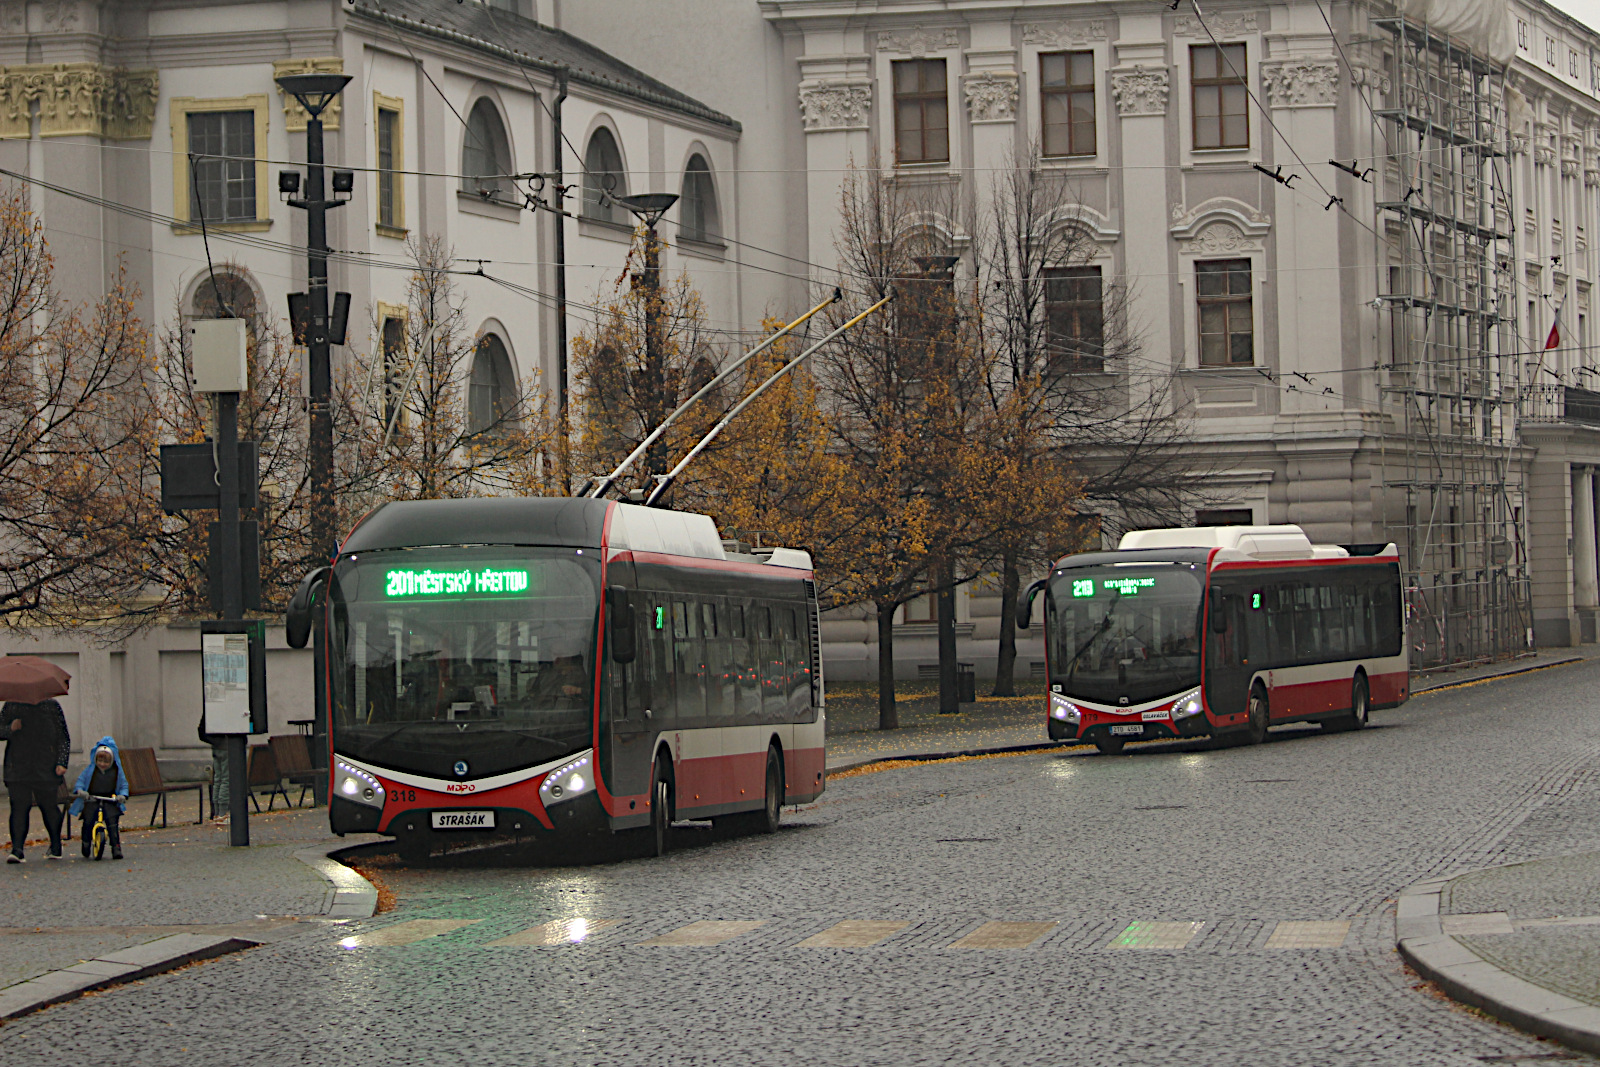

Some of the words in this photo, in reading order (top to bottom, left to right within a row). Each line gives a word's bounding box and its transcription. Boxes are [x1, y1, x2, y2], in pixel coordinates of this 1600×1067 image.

[387, 571, 414, 595] 201
[414, 569, 471, 593] MĚSTSKÝ
[446, 784, 476, 792] MDPO
[391, 790, 416, 802] 318
[439, 812, 485, 825] STRAŠÁK
